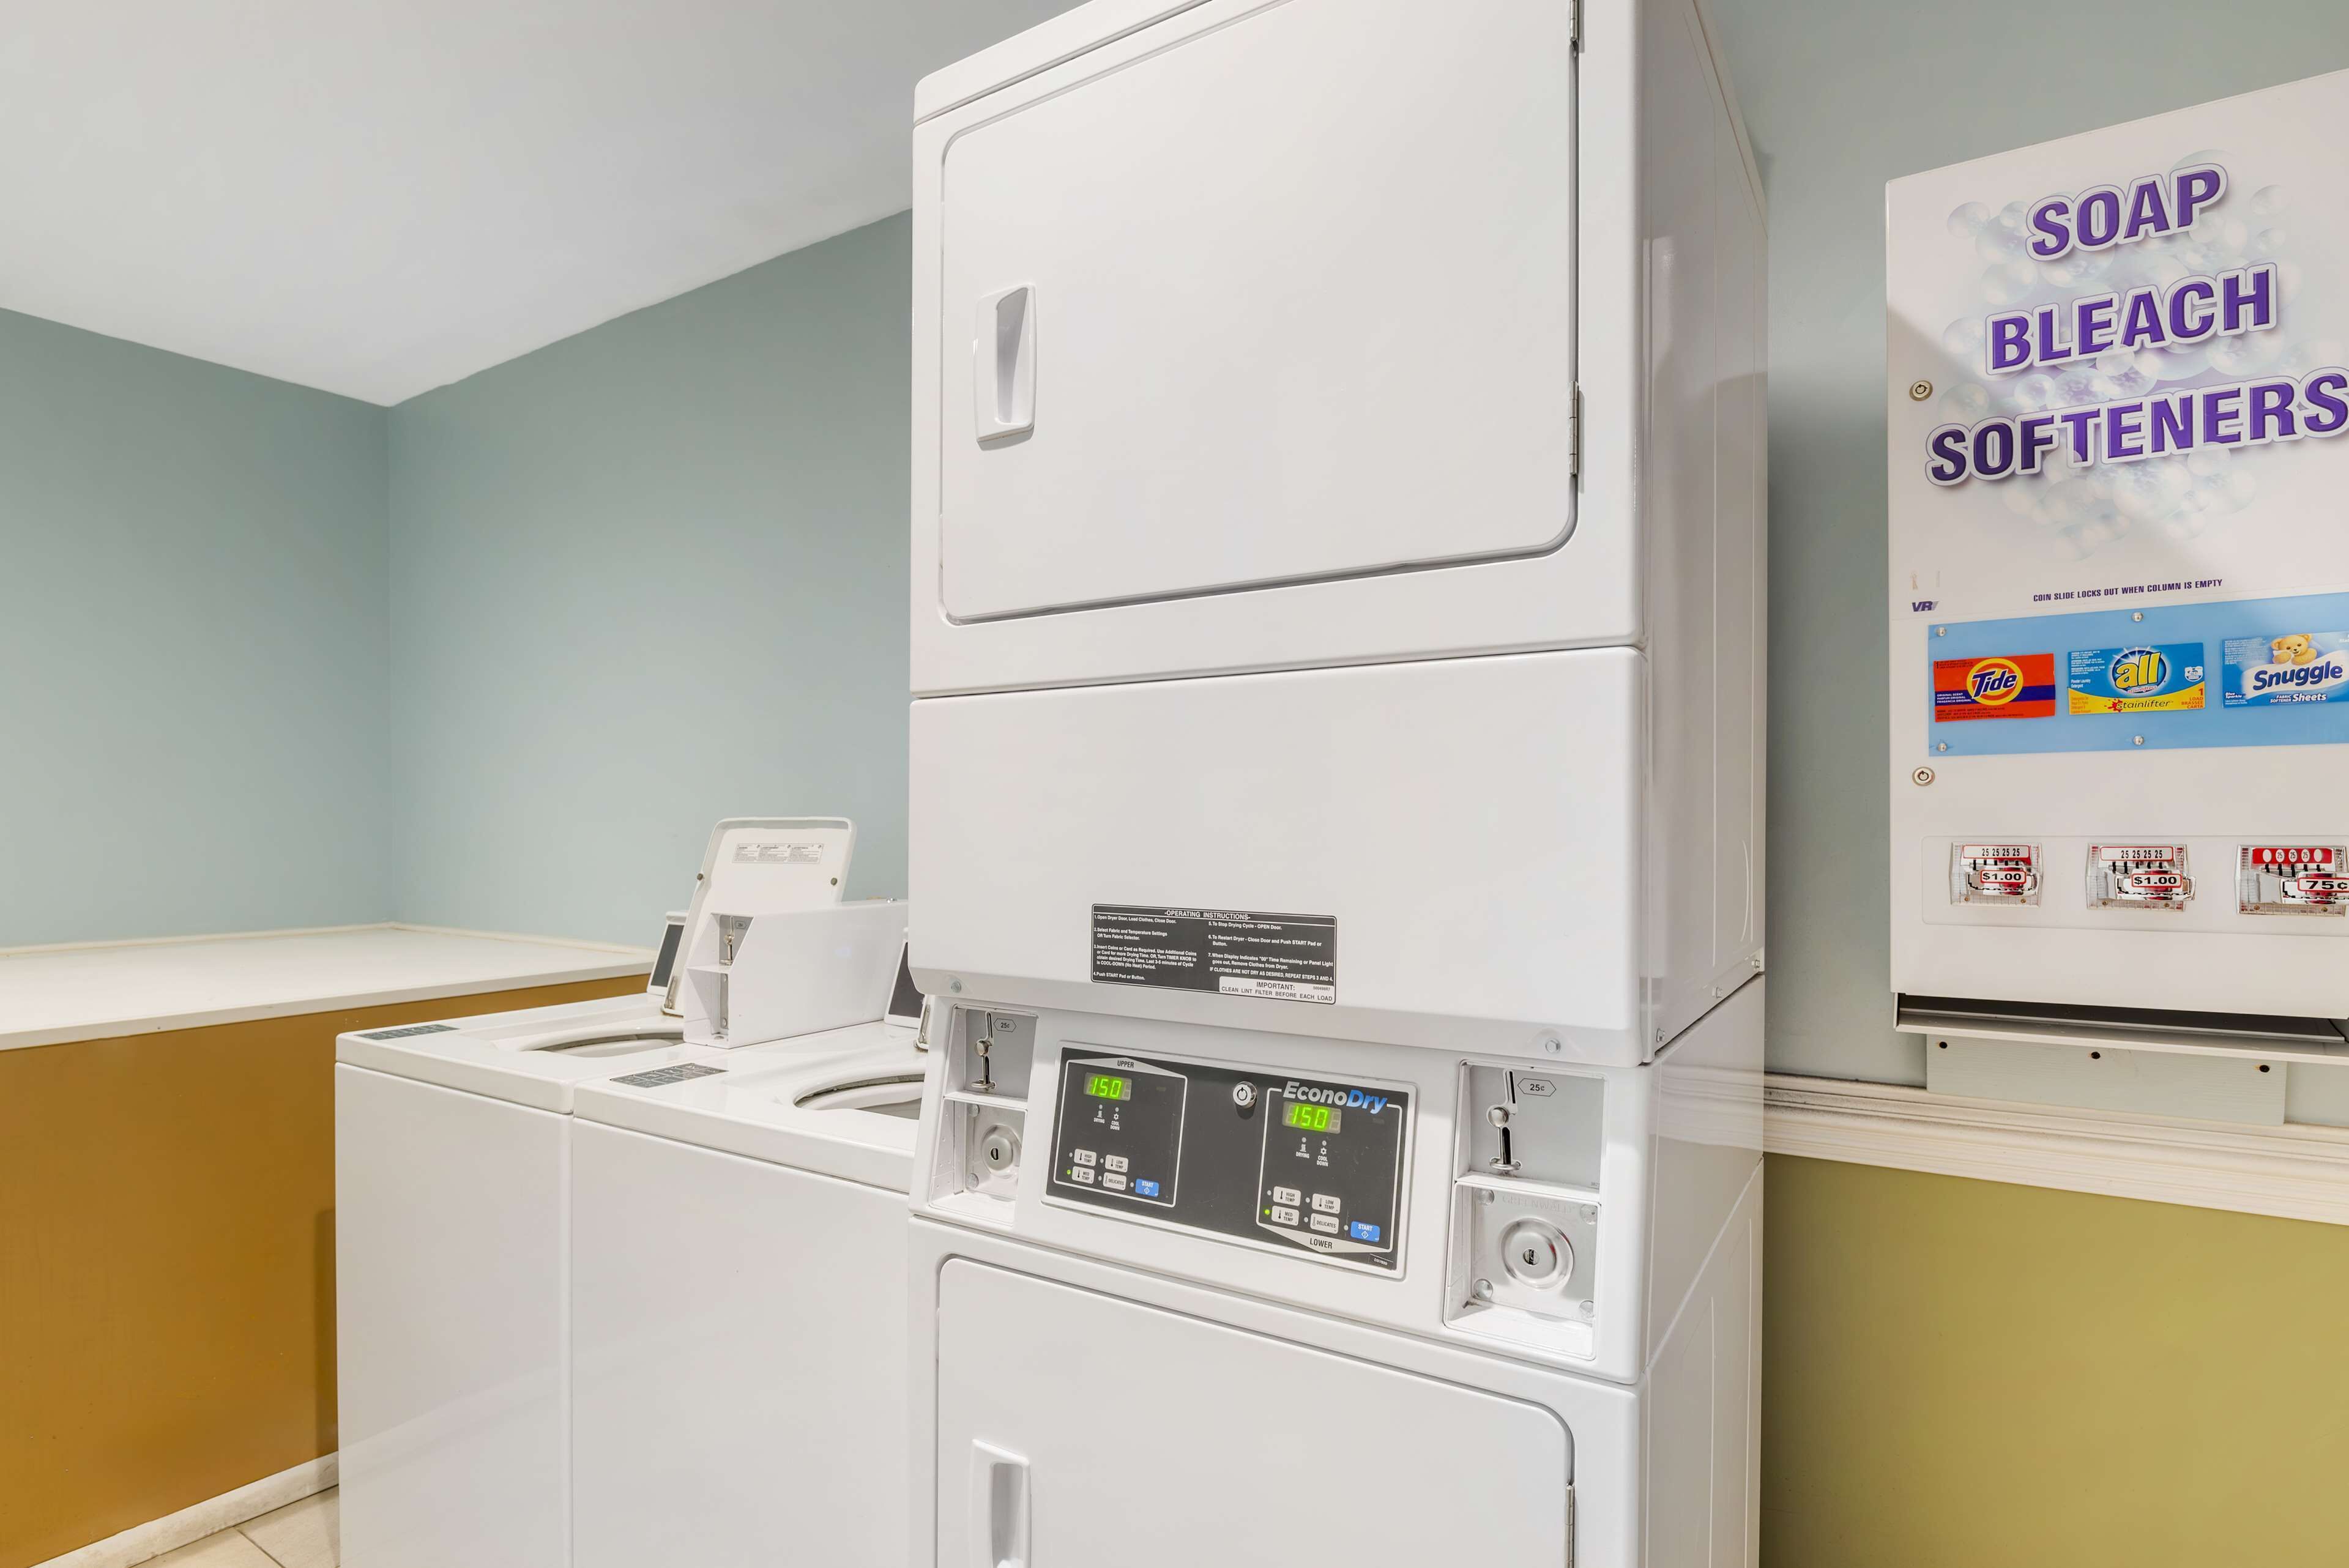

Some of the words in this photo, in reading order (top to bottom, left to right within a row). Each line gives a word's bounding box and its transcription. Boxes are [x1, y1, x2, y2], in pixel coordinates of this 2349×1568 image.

[2031, 169, 2222, 256] SOAP
[1992, 269, 2270, 370] BLEACH
[1931, 373, 2348, 481] SOFTENERS
[2077, 590, 2101, 598] LOCKS
[2147, 583, 2181, 592] COLUMN
[2115, 652, 2161, 689] all
[2253, 661, 2343, 690] Snuggle
[1972, 669, 2017, 698] Tide
[2117, 700, 2170, 709] stainlifter
[2293, 693, 2326, 702] Sheets
[2155, 850, 2162, 858] 25
[2306, 881, 2348, 890] 75¢
[1257, 982, 1295, 990] IMPORTANT:
[1092, 1078, 1122, 1098] 150
[1283, 1081, 1387, 1114] EconoDry
[1292, 1106, 1328, 1128] 150
[1310, 1238, 1333, 1249] LOWER
